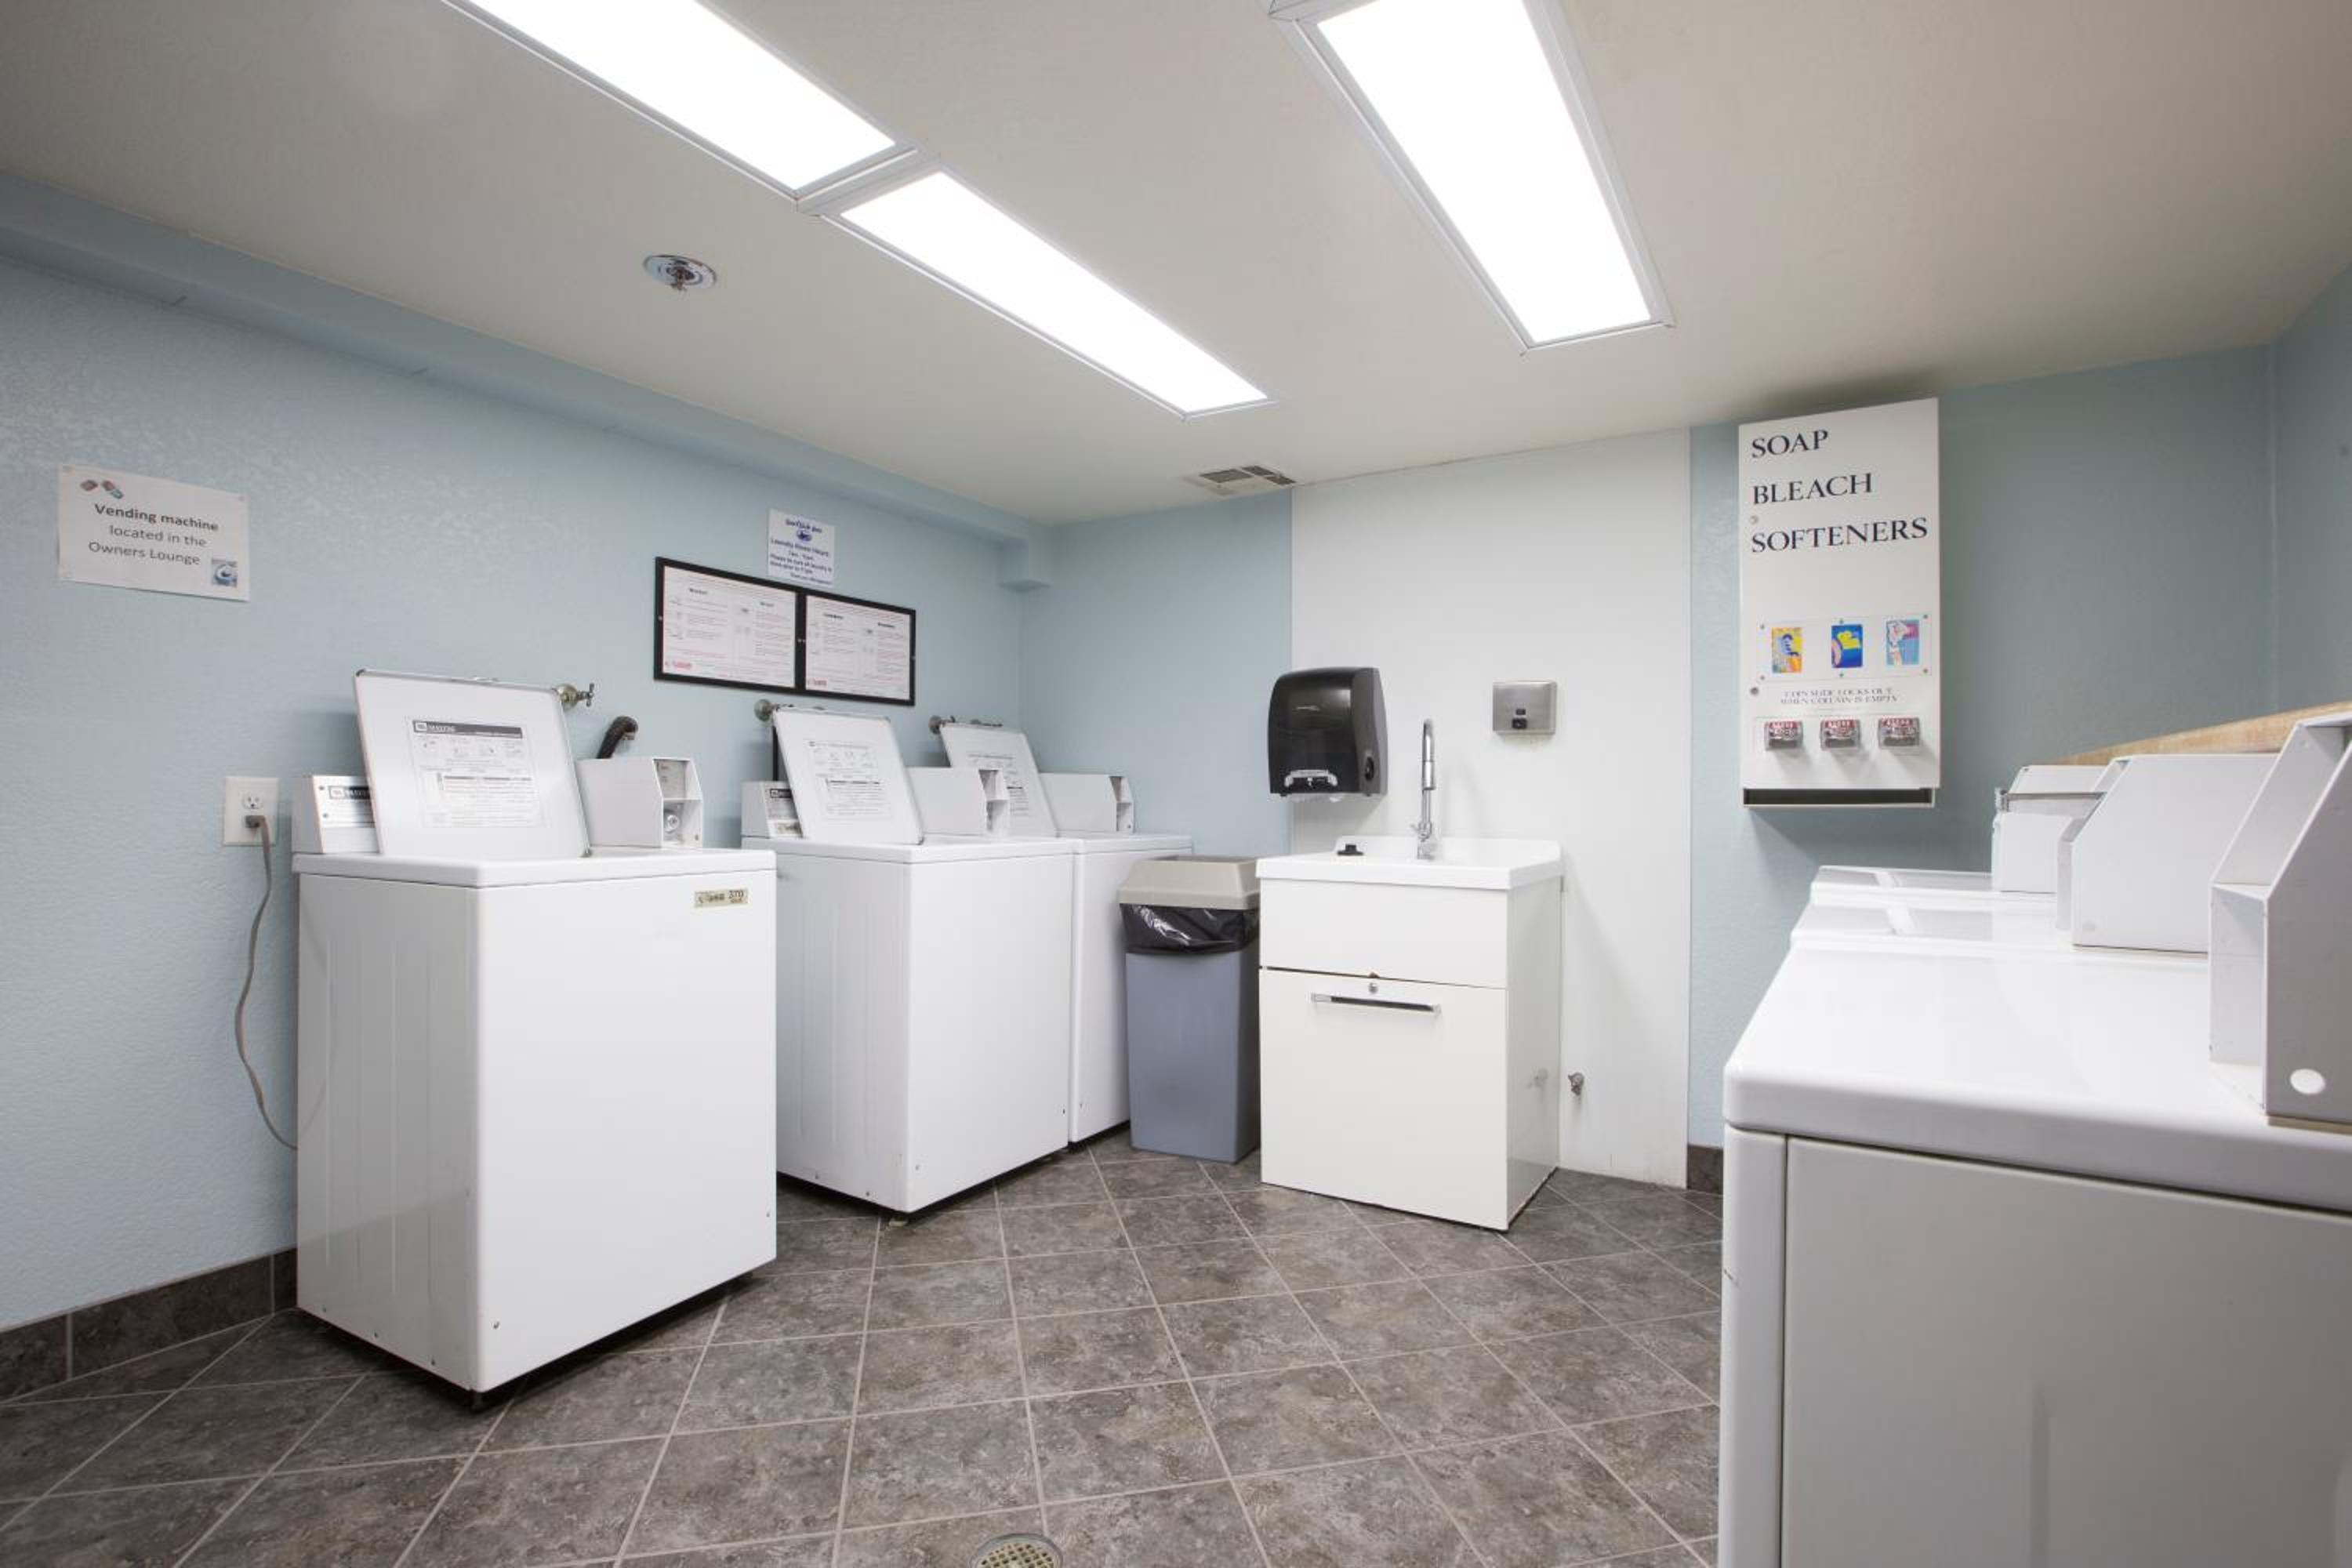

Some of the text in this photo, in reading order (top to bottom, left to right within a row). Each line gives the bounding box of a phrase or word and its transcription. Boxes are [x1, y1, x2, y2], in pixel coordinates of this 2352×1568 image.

[1751, 429, 1828, 459] SOAP
[1752, 472, 1873, 505] BLEACH
[94, 503, 219, 532] Vending machine
[110, 524, 207, 547] located in the
[1751, 517, 1928, 553] SOFTENERS
[89, 541, 201, 565] Owners Lounge
